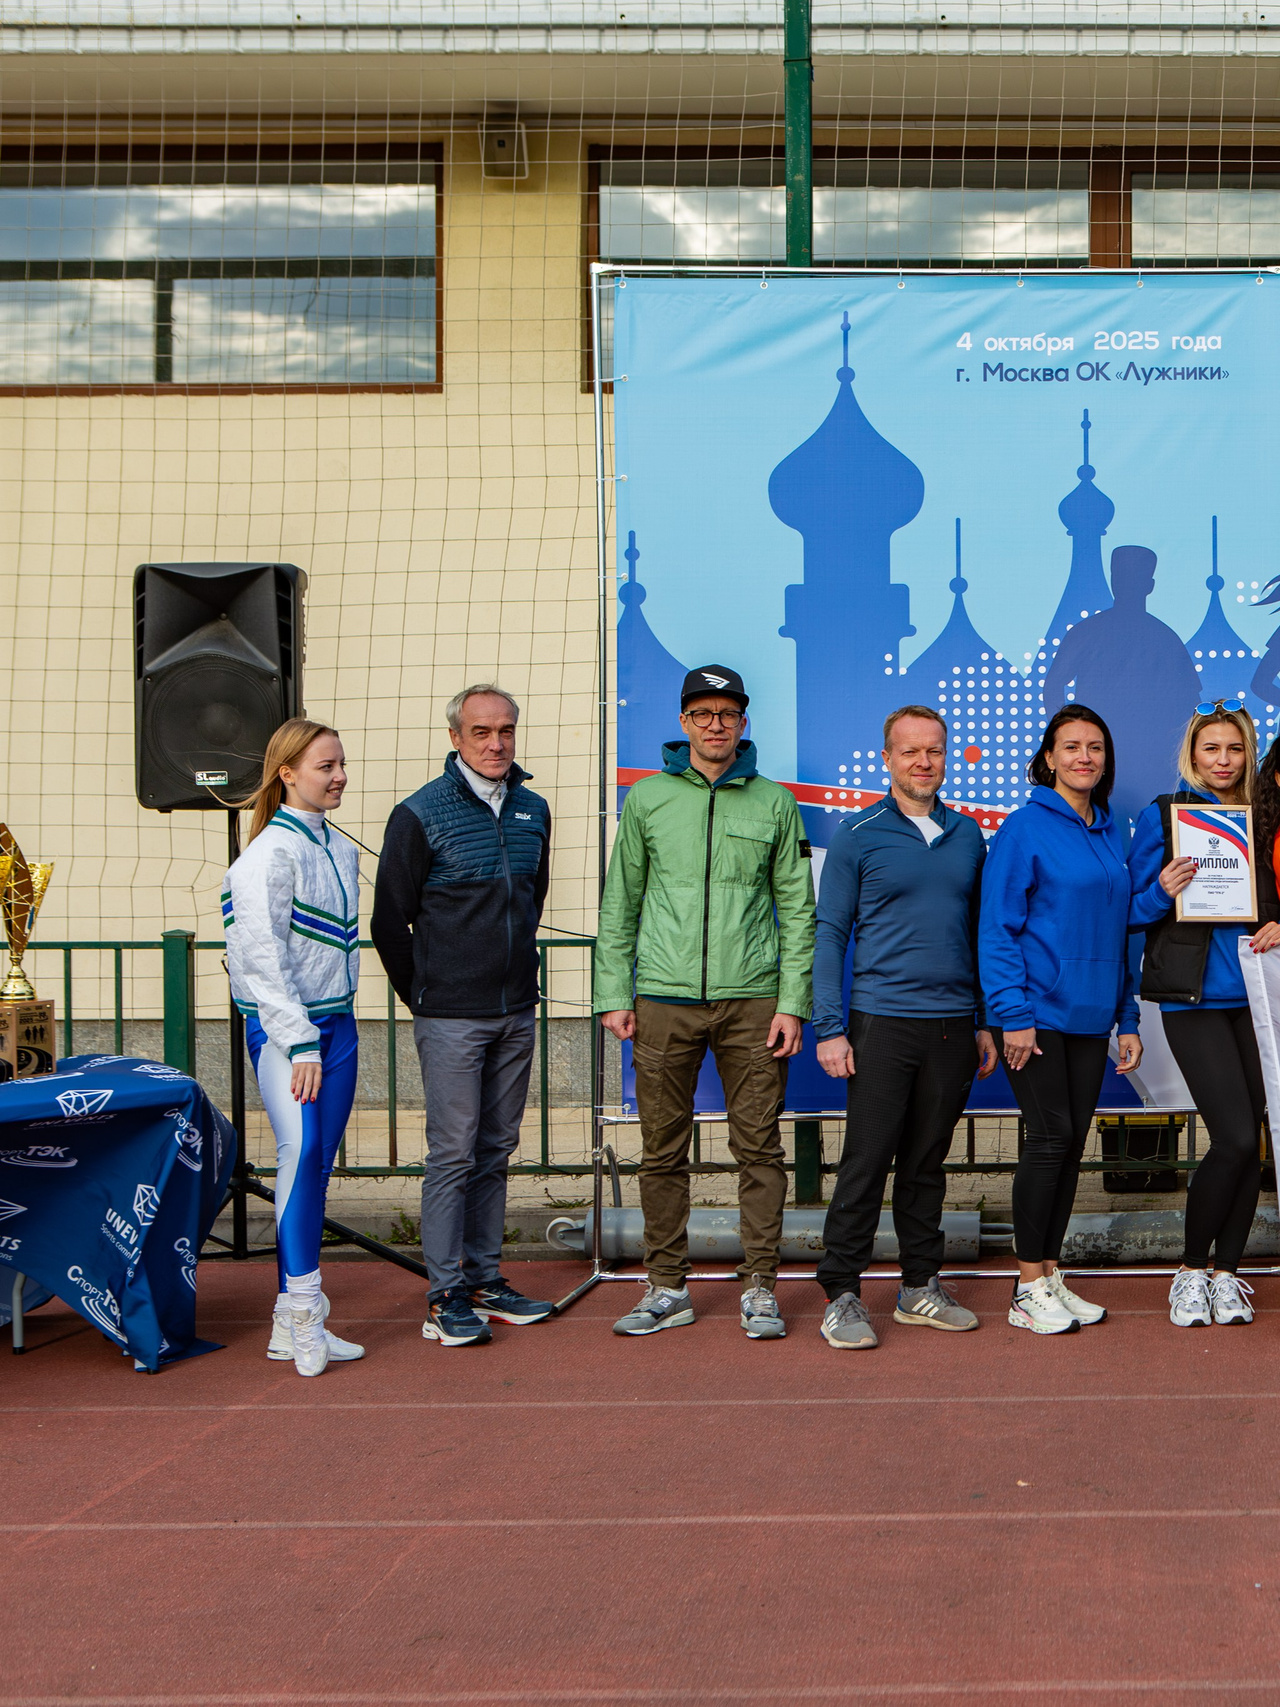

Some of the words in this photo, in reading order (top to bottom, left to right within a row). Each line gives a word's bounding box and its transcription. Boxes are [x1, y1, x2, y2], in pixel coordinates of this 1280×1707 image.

[956, 332, 973, 351] 4
[984, 332, 1074, 356] октября
[1094, 331, 1160, 350] 2025
[1172, 335, 1222, 352] года
[956, 368, 970, 383] г.
[982, 362, 1070, 383] Москва
[1075, 361, 1111, 382] ОК
[1115, 361, 1230, 386] «Лужники»
[1193, 857, 1239, 870] ДИПЛОМ
